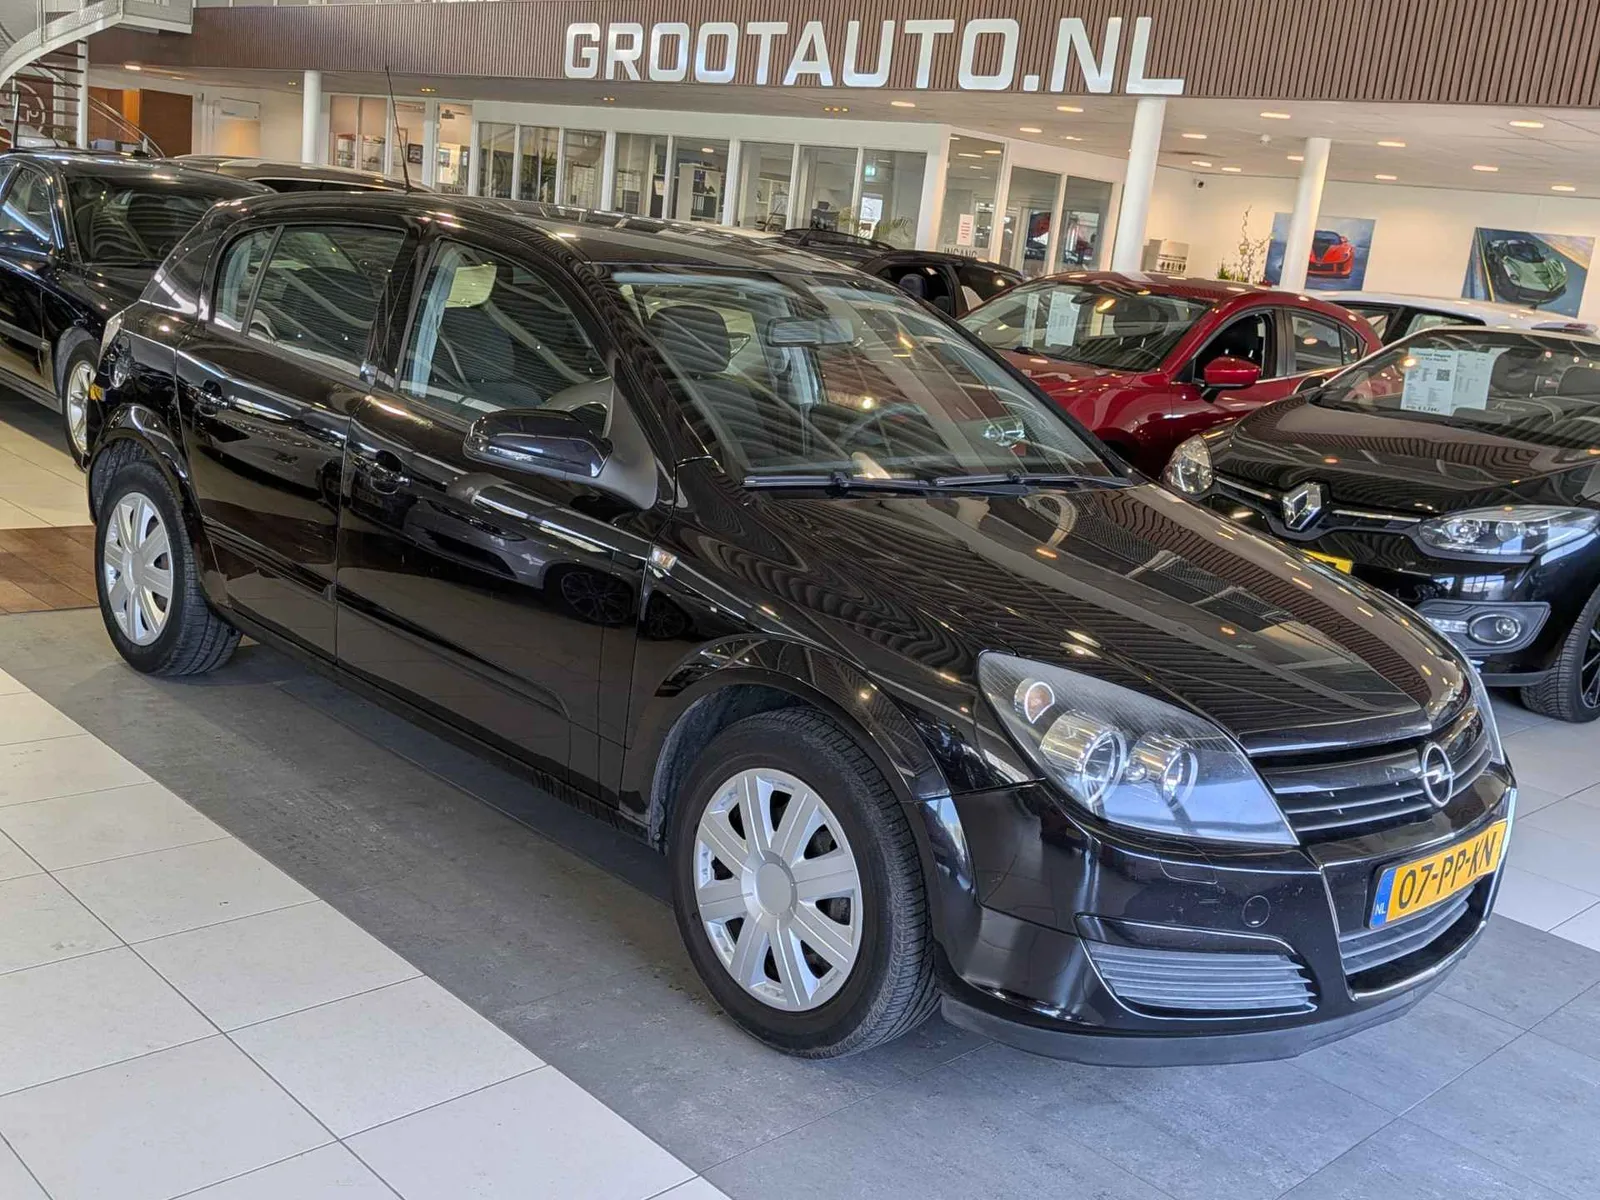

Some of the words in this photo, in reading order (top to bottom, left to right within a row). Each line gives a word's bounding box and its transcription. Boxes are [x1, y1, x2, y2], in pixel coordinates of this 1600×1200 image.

[564, 16, 1184, 95] GROOTAUTO.NL
[1374, 902, 1386, 915] NL
[1398, 831, 1497, 909] 07-PP-KN
